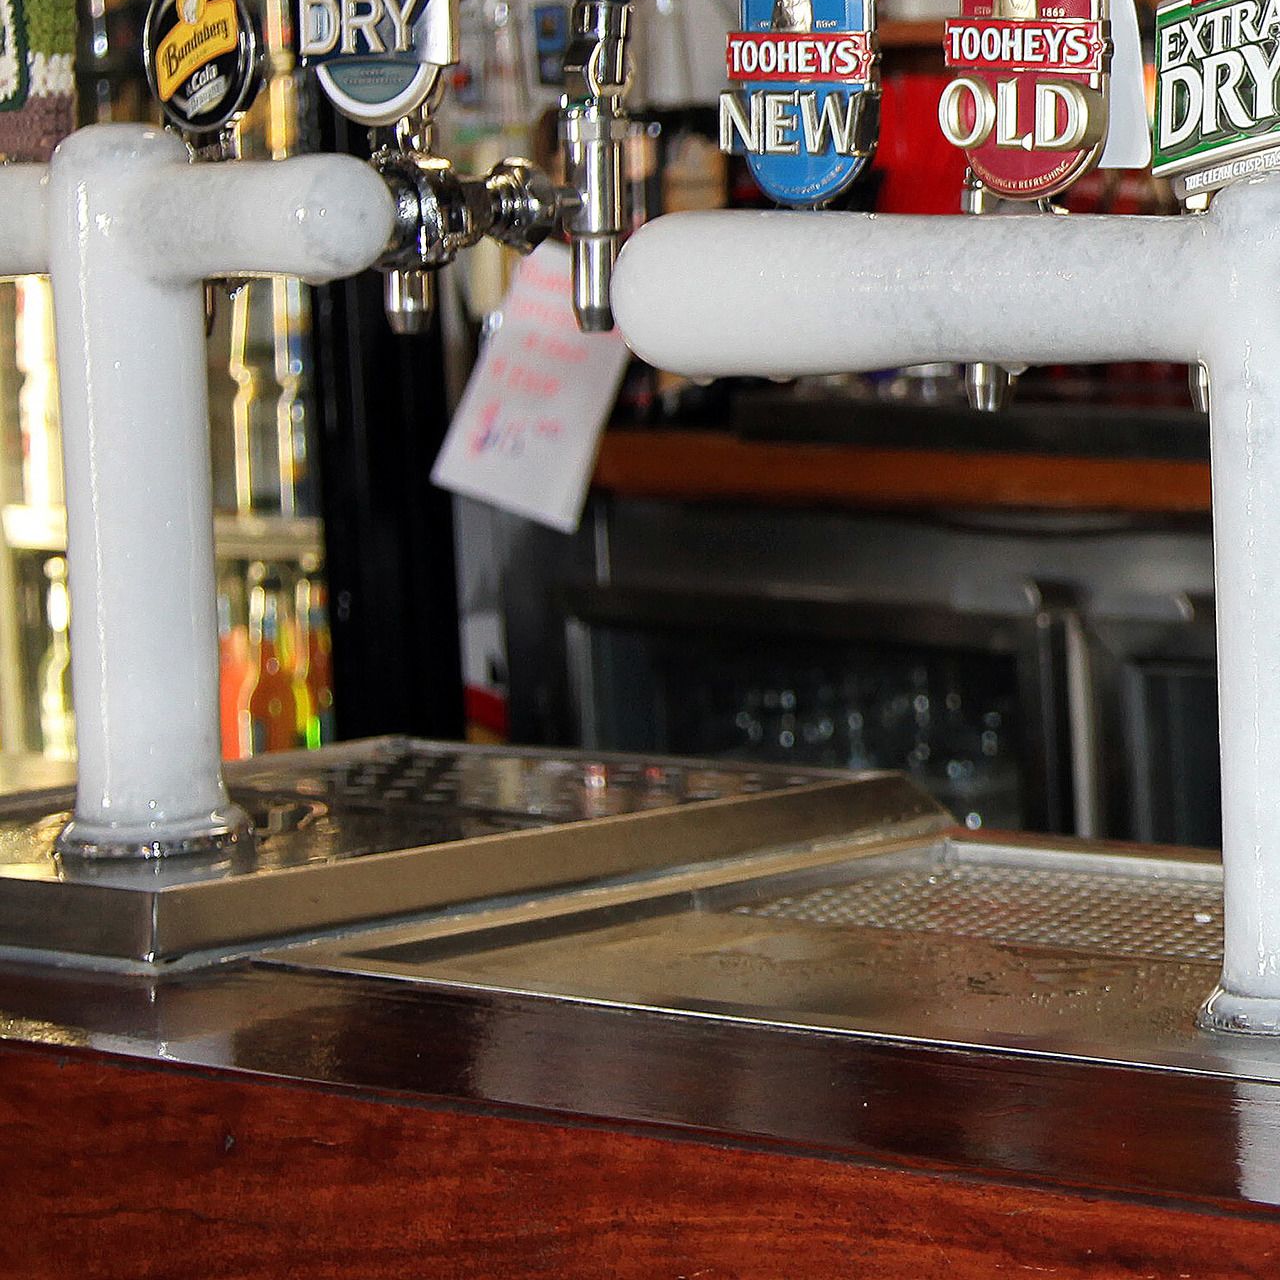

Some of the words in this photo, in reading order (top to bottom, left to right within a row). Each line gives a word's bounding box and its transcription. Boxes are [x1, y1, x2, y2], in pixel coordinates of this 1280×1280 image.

[1041, 7, 1066, 17] 1869
[730, 39, 859, 75] TOOHEYS
[948, 26, 1089, 64] TOOHEYS
[719, 90, 858, 156] NEW
[938, 77, 1089, 151] OLD
[1018, 159, 1070, 189] REFRESHING
[1202, 163, 1233, 185] CLEAN
[1233, 155, 1263, 176] CRISP
